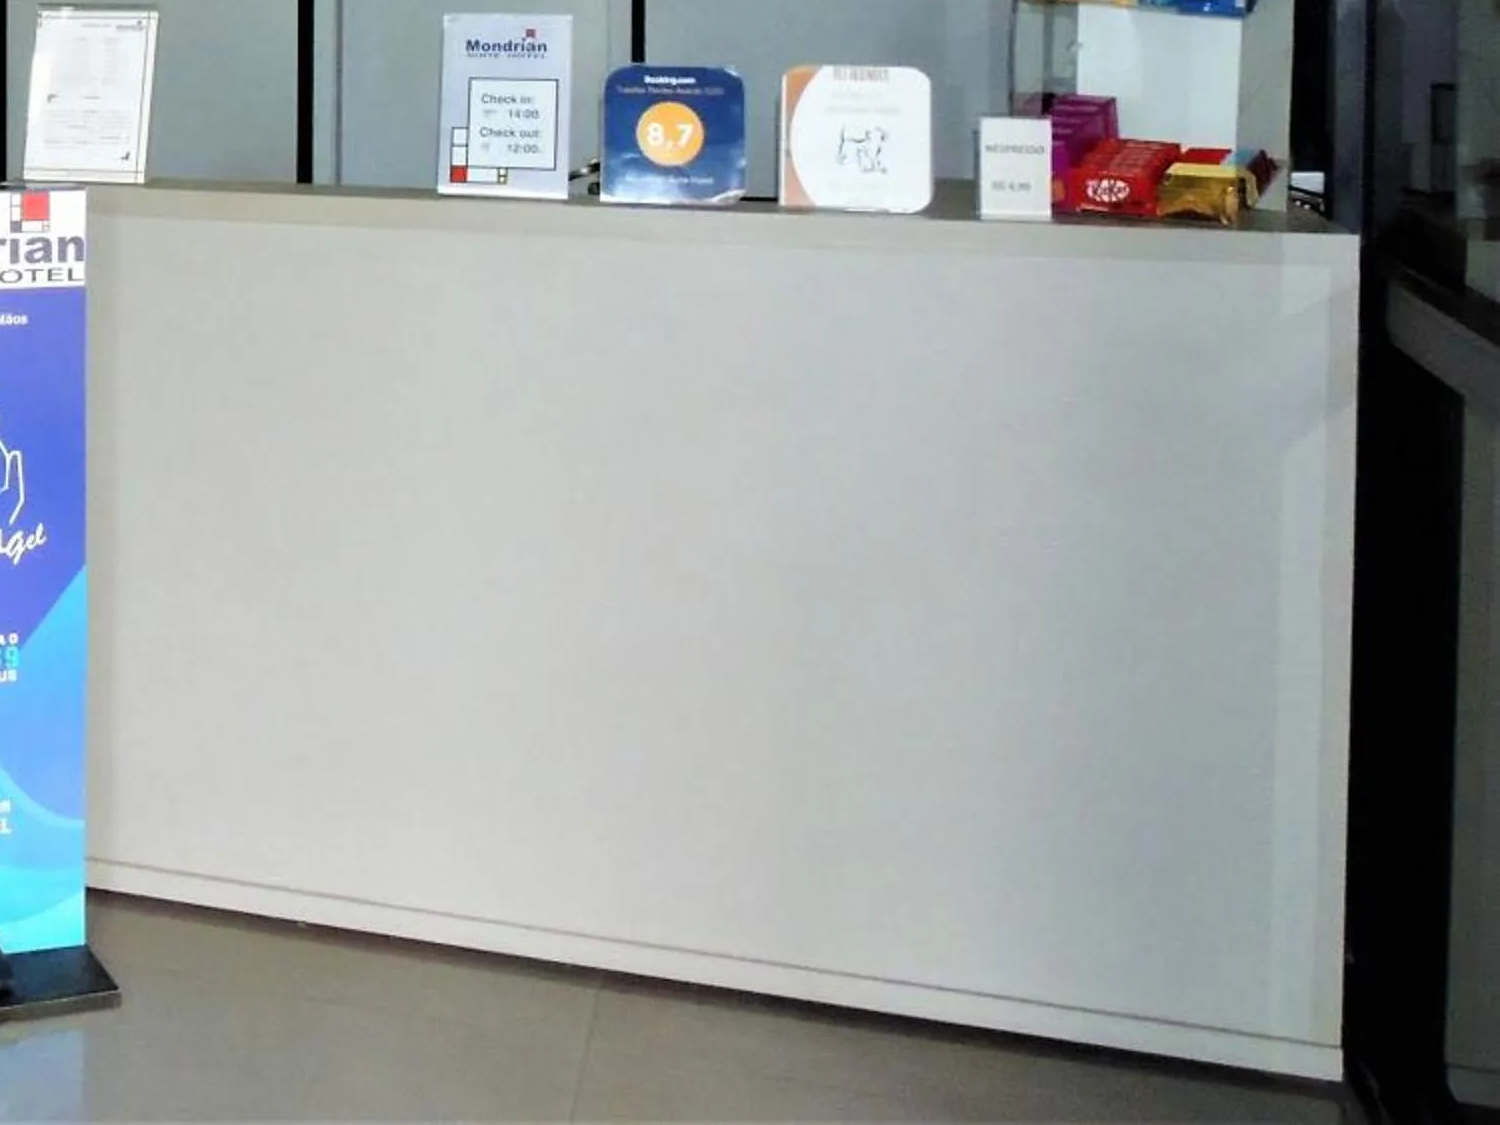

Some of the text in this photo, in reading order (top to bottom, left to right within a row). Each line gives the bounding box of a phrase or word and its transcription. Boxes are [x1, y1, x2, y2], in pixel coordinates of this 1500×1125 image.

[465, 38, 547, 52] Mondrian
[481, 93, 516, 104] Check
[480, 127, 516, 138] Check
[647, 122, 693, 148] 8,7
